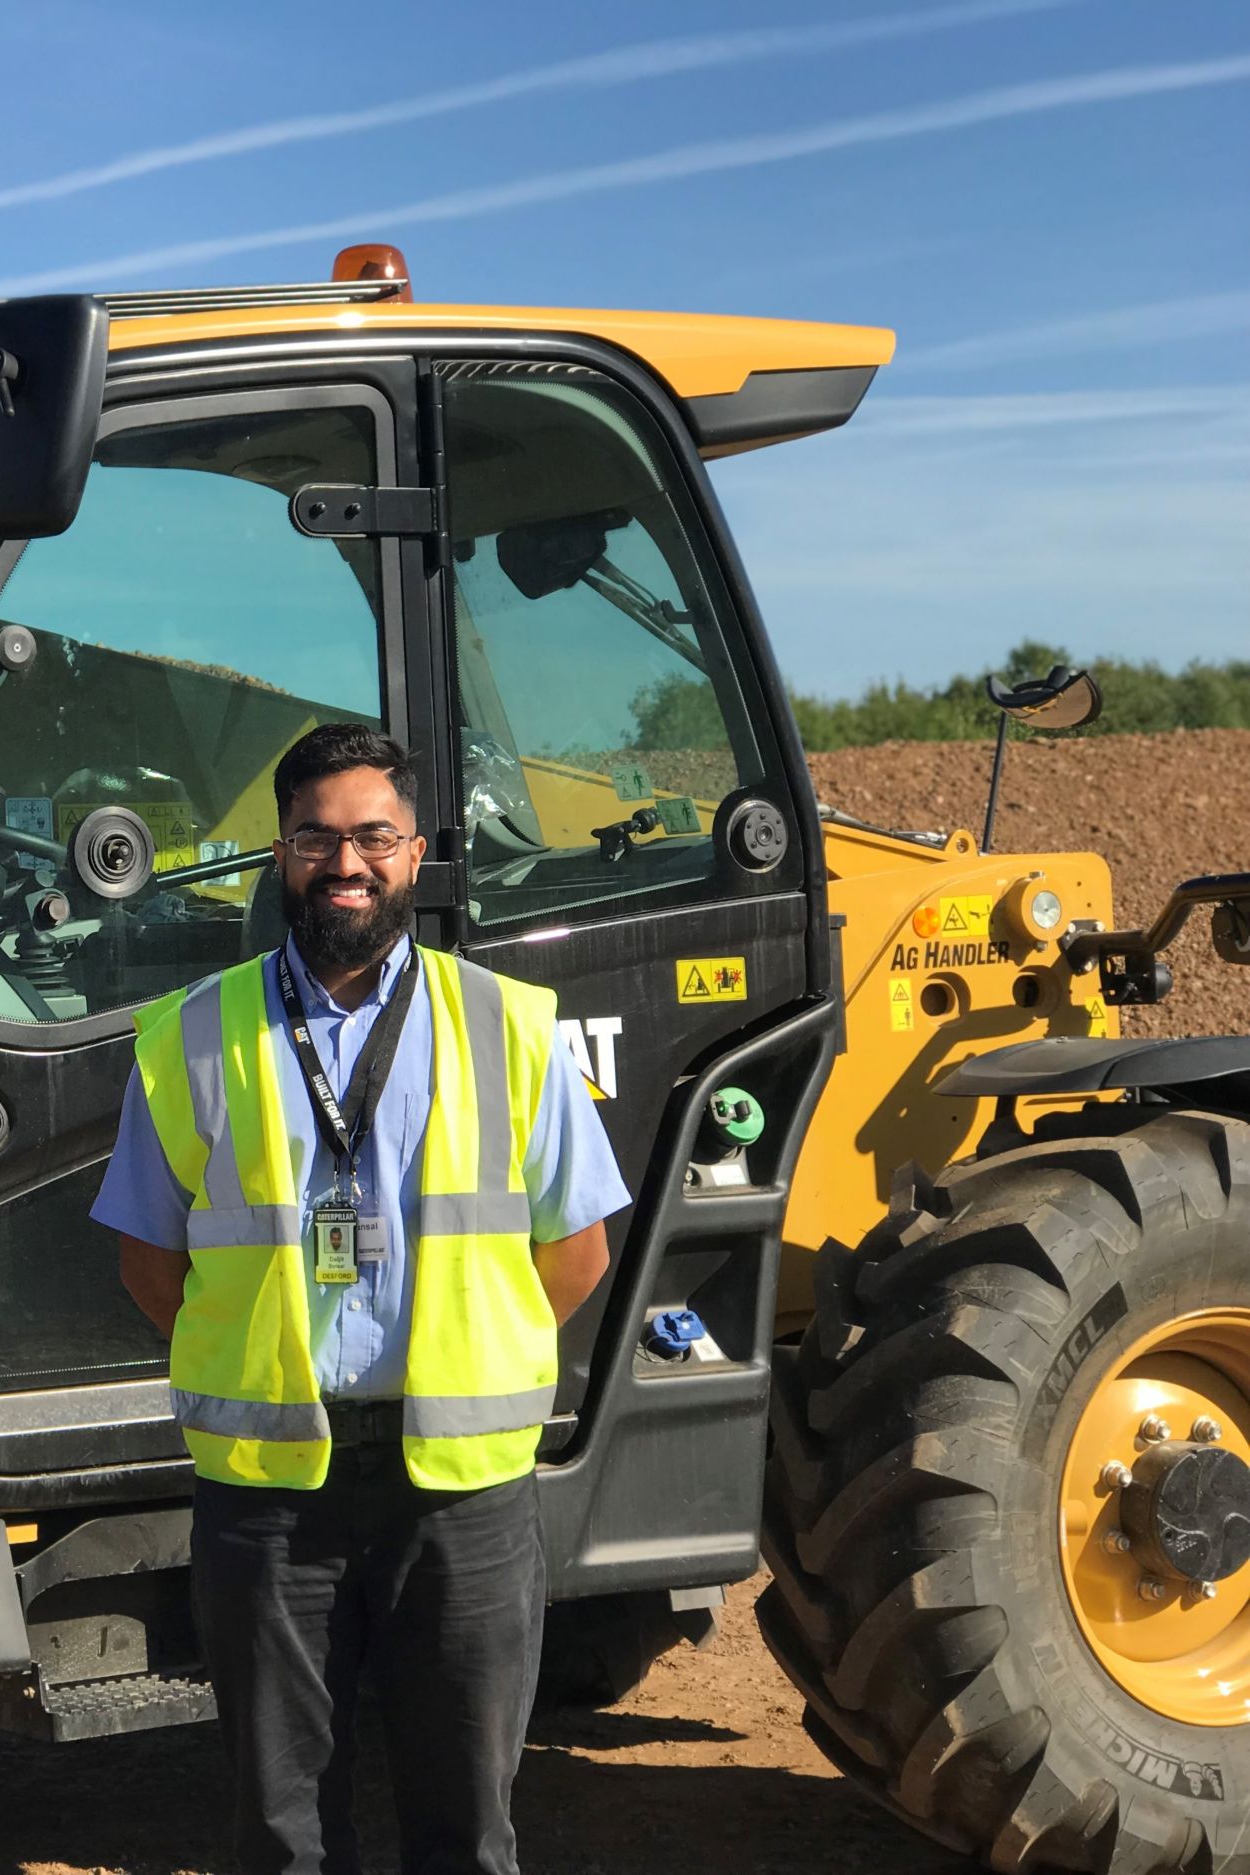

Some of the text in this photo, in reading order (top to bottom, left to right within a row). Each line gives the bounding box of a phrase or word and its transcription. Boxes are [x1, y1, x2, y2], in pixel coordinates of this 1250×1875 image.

[924, 940, 1010, 969] HANDLER
[281, 975, 293, 991] FOR
[294, 1026, 310, 1045] CAT
[558, 1016, 623, 1099] AT
[312, 1073, 332, 1103] BUILT
[324, 1100, 341, 1122] FOR
[357, 1222, 378, 1231] ansal
